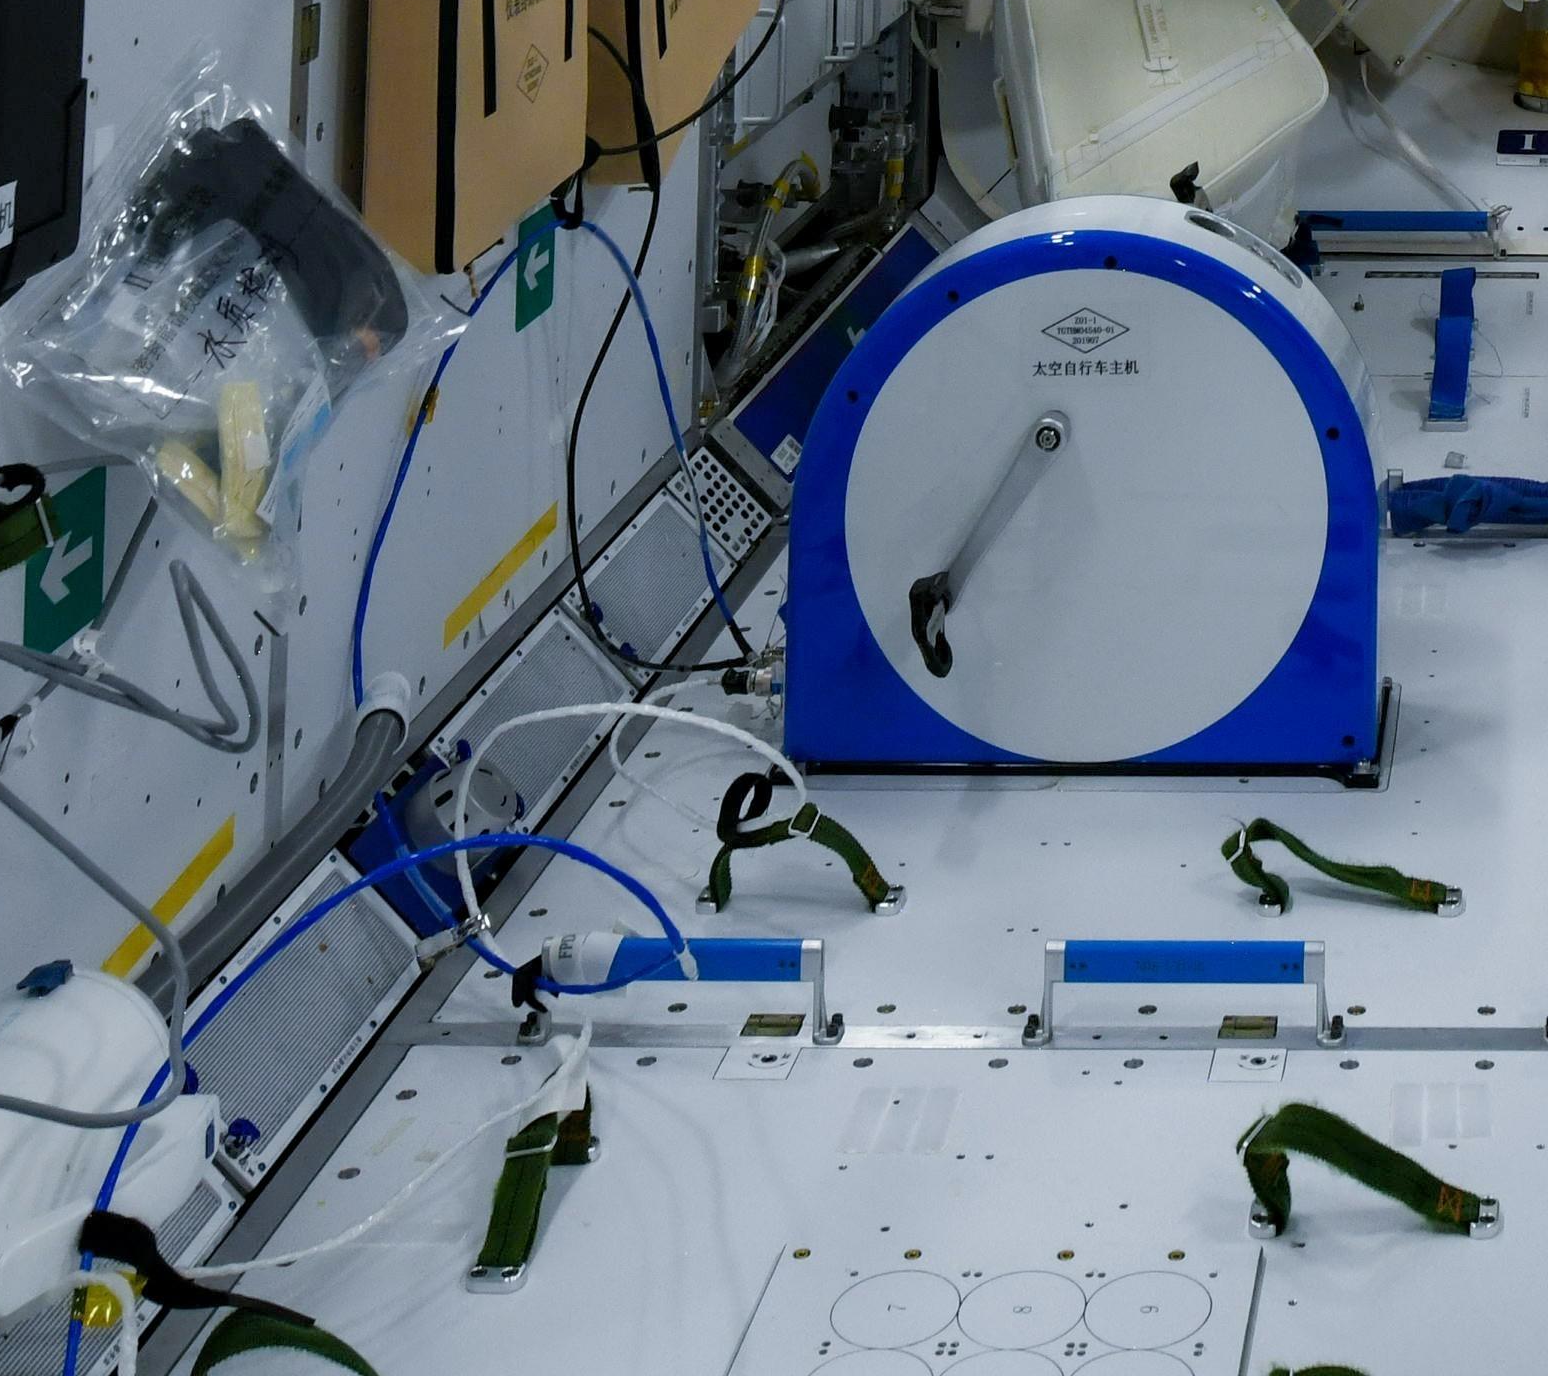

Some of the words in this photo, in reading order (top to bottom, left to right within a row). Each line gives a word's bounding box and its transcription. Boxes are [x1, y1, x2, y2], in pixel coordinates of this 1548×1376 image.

[1521, 133, 1536, 151] I
[1032, 358, 1140, 378] 太空自行车主机
